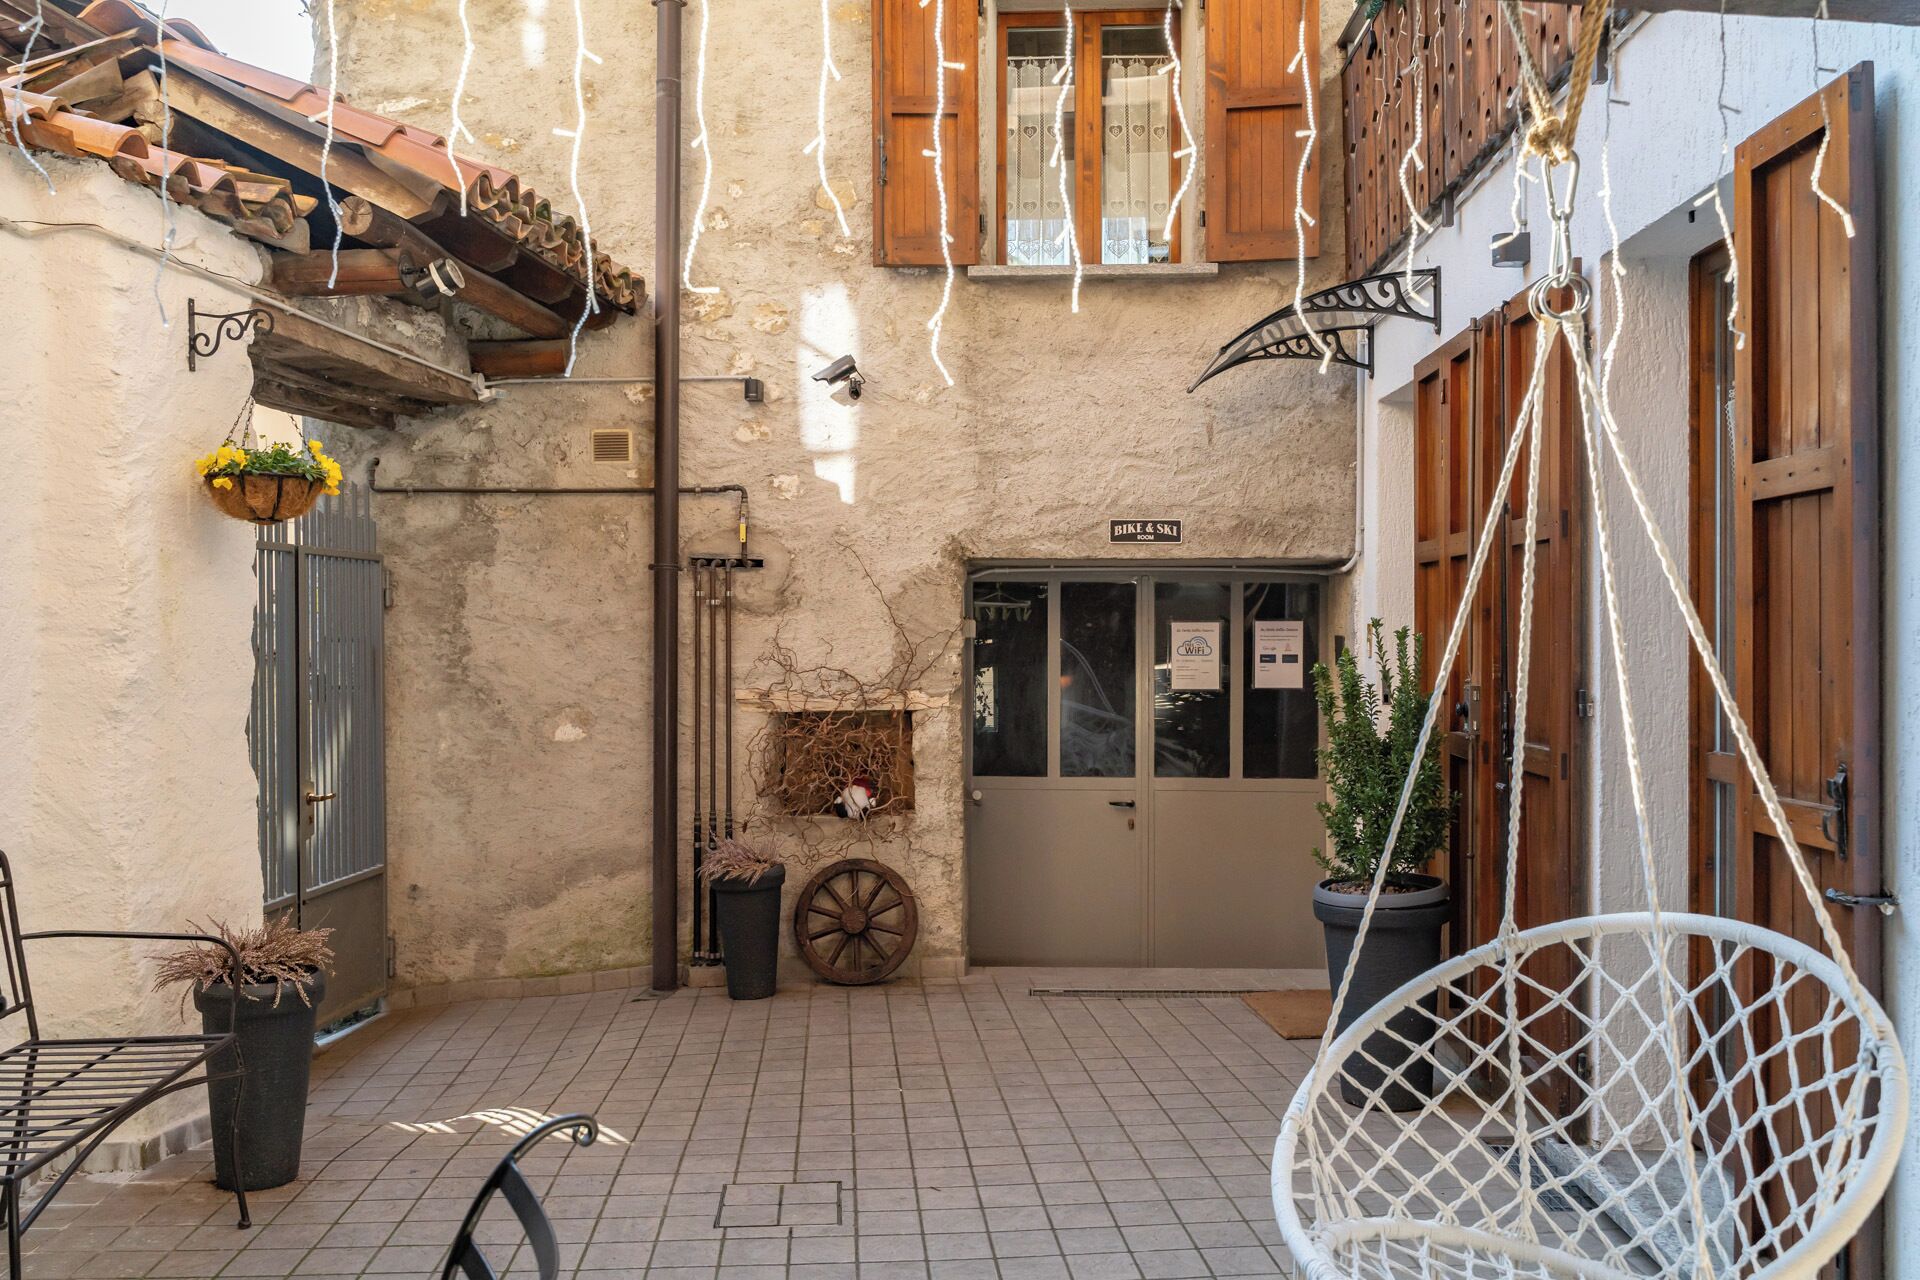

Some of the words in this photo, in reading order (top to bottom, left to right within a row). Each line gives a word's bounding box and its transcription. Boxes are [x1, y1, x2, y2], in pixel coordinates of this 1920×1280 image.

[1114, 523, 1143, 536] BIKE
[1145, 523, 1154, 533] &
[1156, 523, 1178, 536] SKI
[1184, 646, 1205, 654] WiFi
